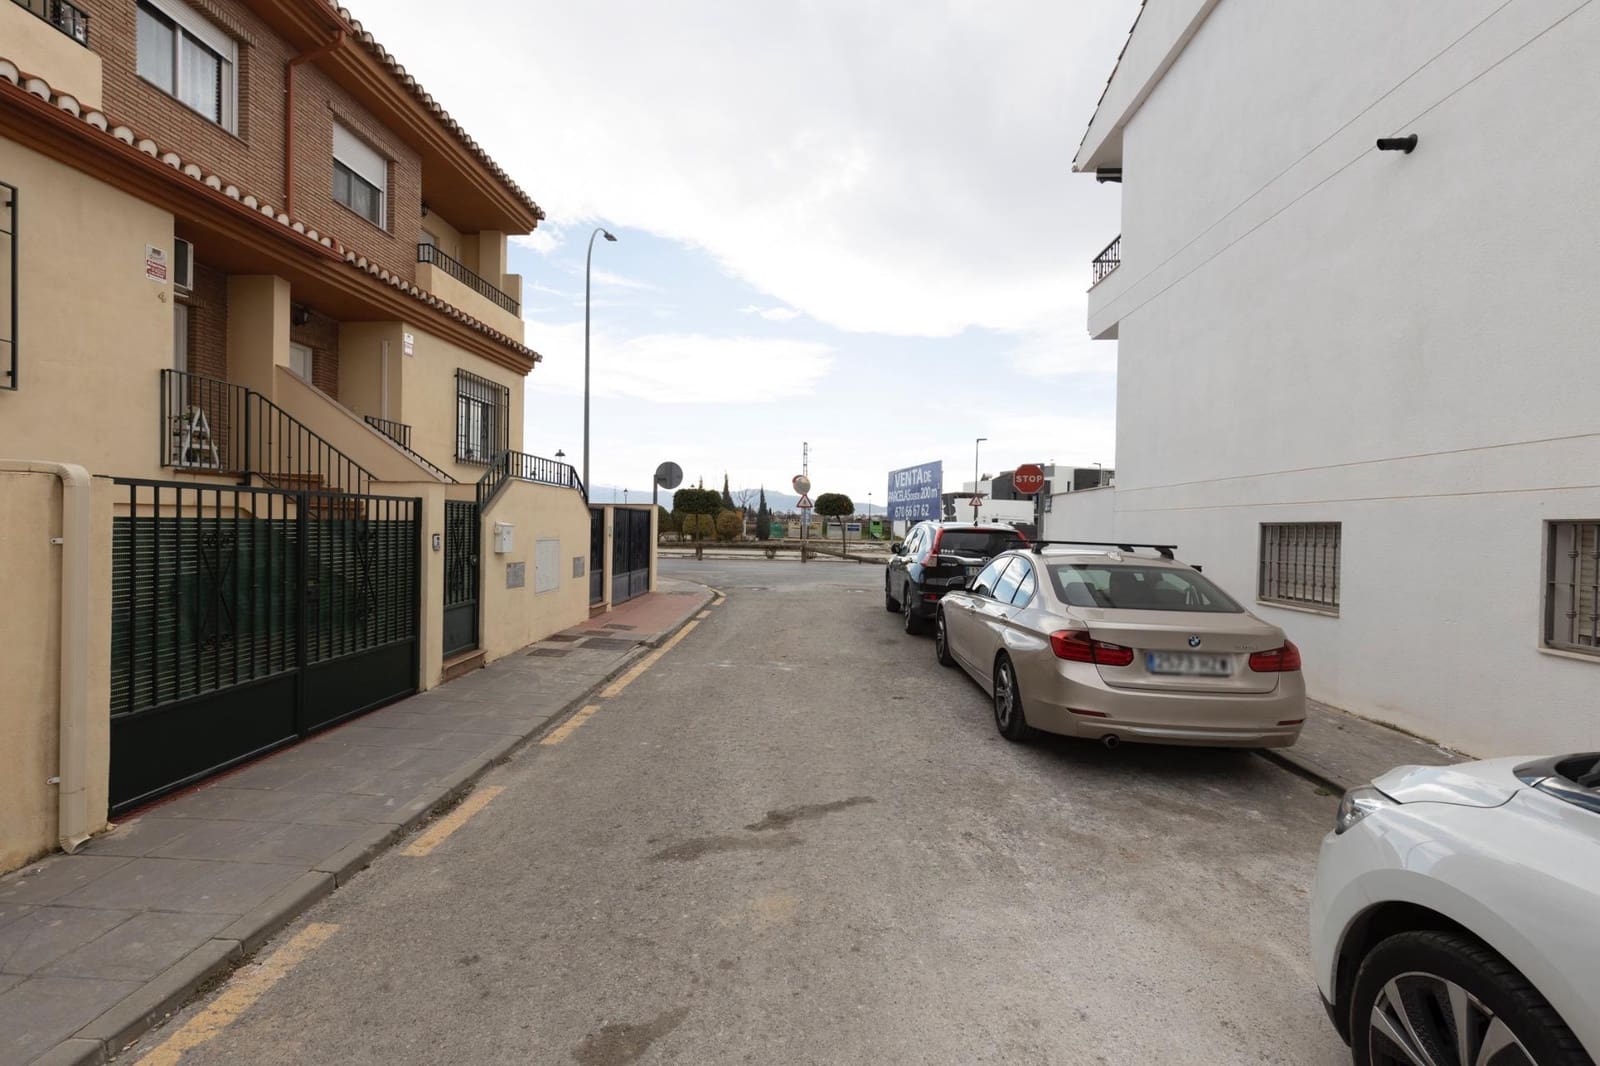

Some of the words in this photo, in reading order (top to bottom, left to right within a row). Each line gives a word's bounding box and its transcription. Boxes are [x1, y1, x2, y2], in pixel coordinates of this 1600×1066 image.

[895, 468, 923, 488] VENTA
[924, 470, 931, 482] DE
[1015, 475, 1043, 483] STOP
